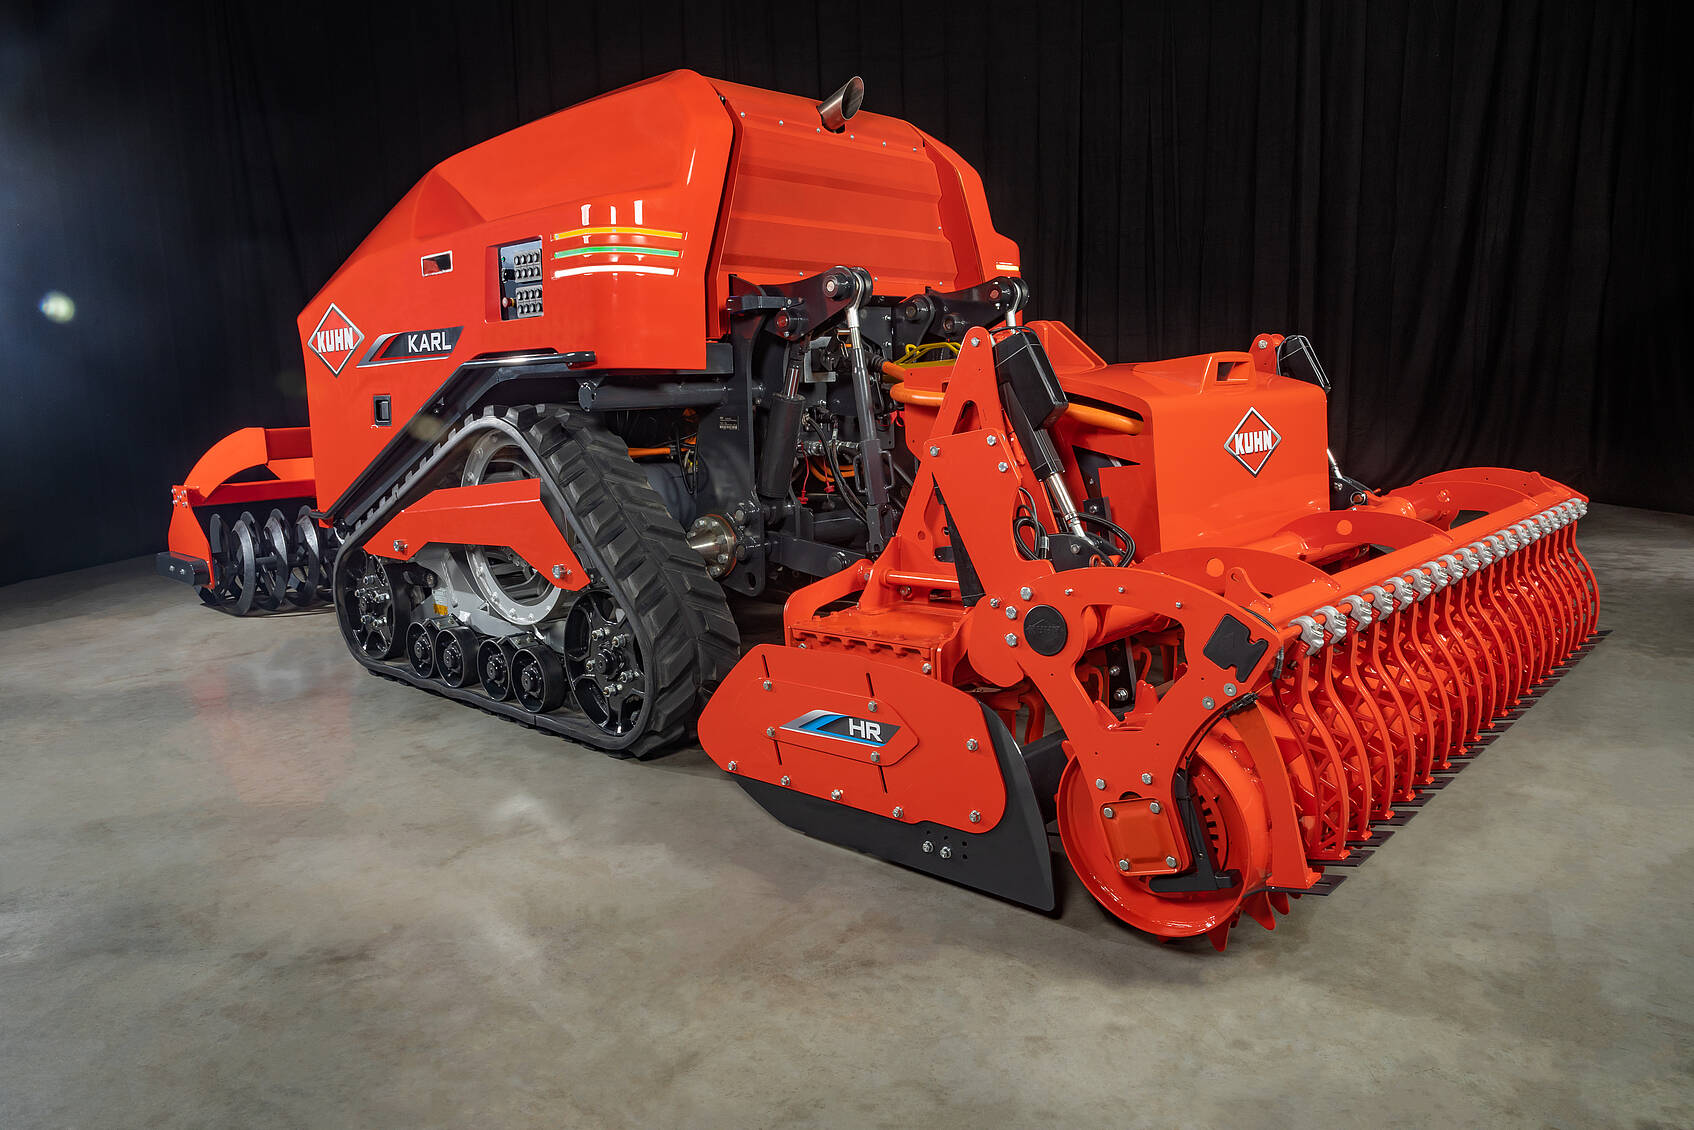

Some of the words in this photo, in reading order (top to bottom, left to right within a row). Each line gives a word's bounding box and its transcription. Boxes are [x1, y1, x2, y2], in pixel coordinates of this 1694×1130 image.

[317, 327, 354, 353] KUHN
[408, 331, 452, 353] KARL
[1234, 429, 1273, 456] KUHN
[848, 718, 883, 742] HR
